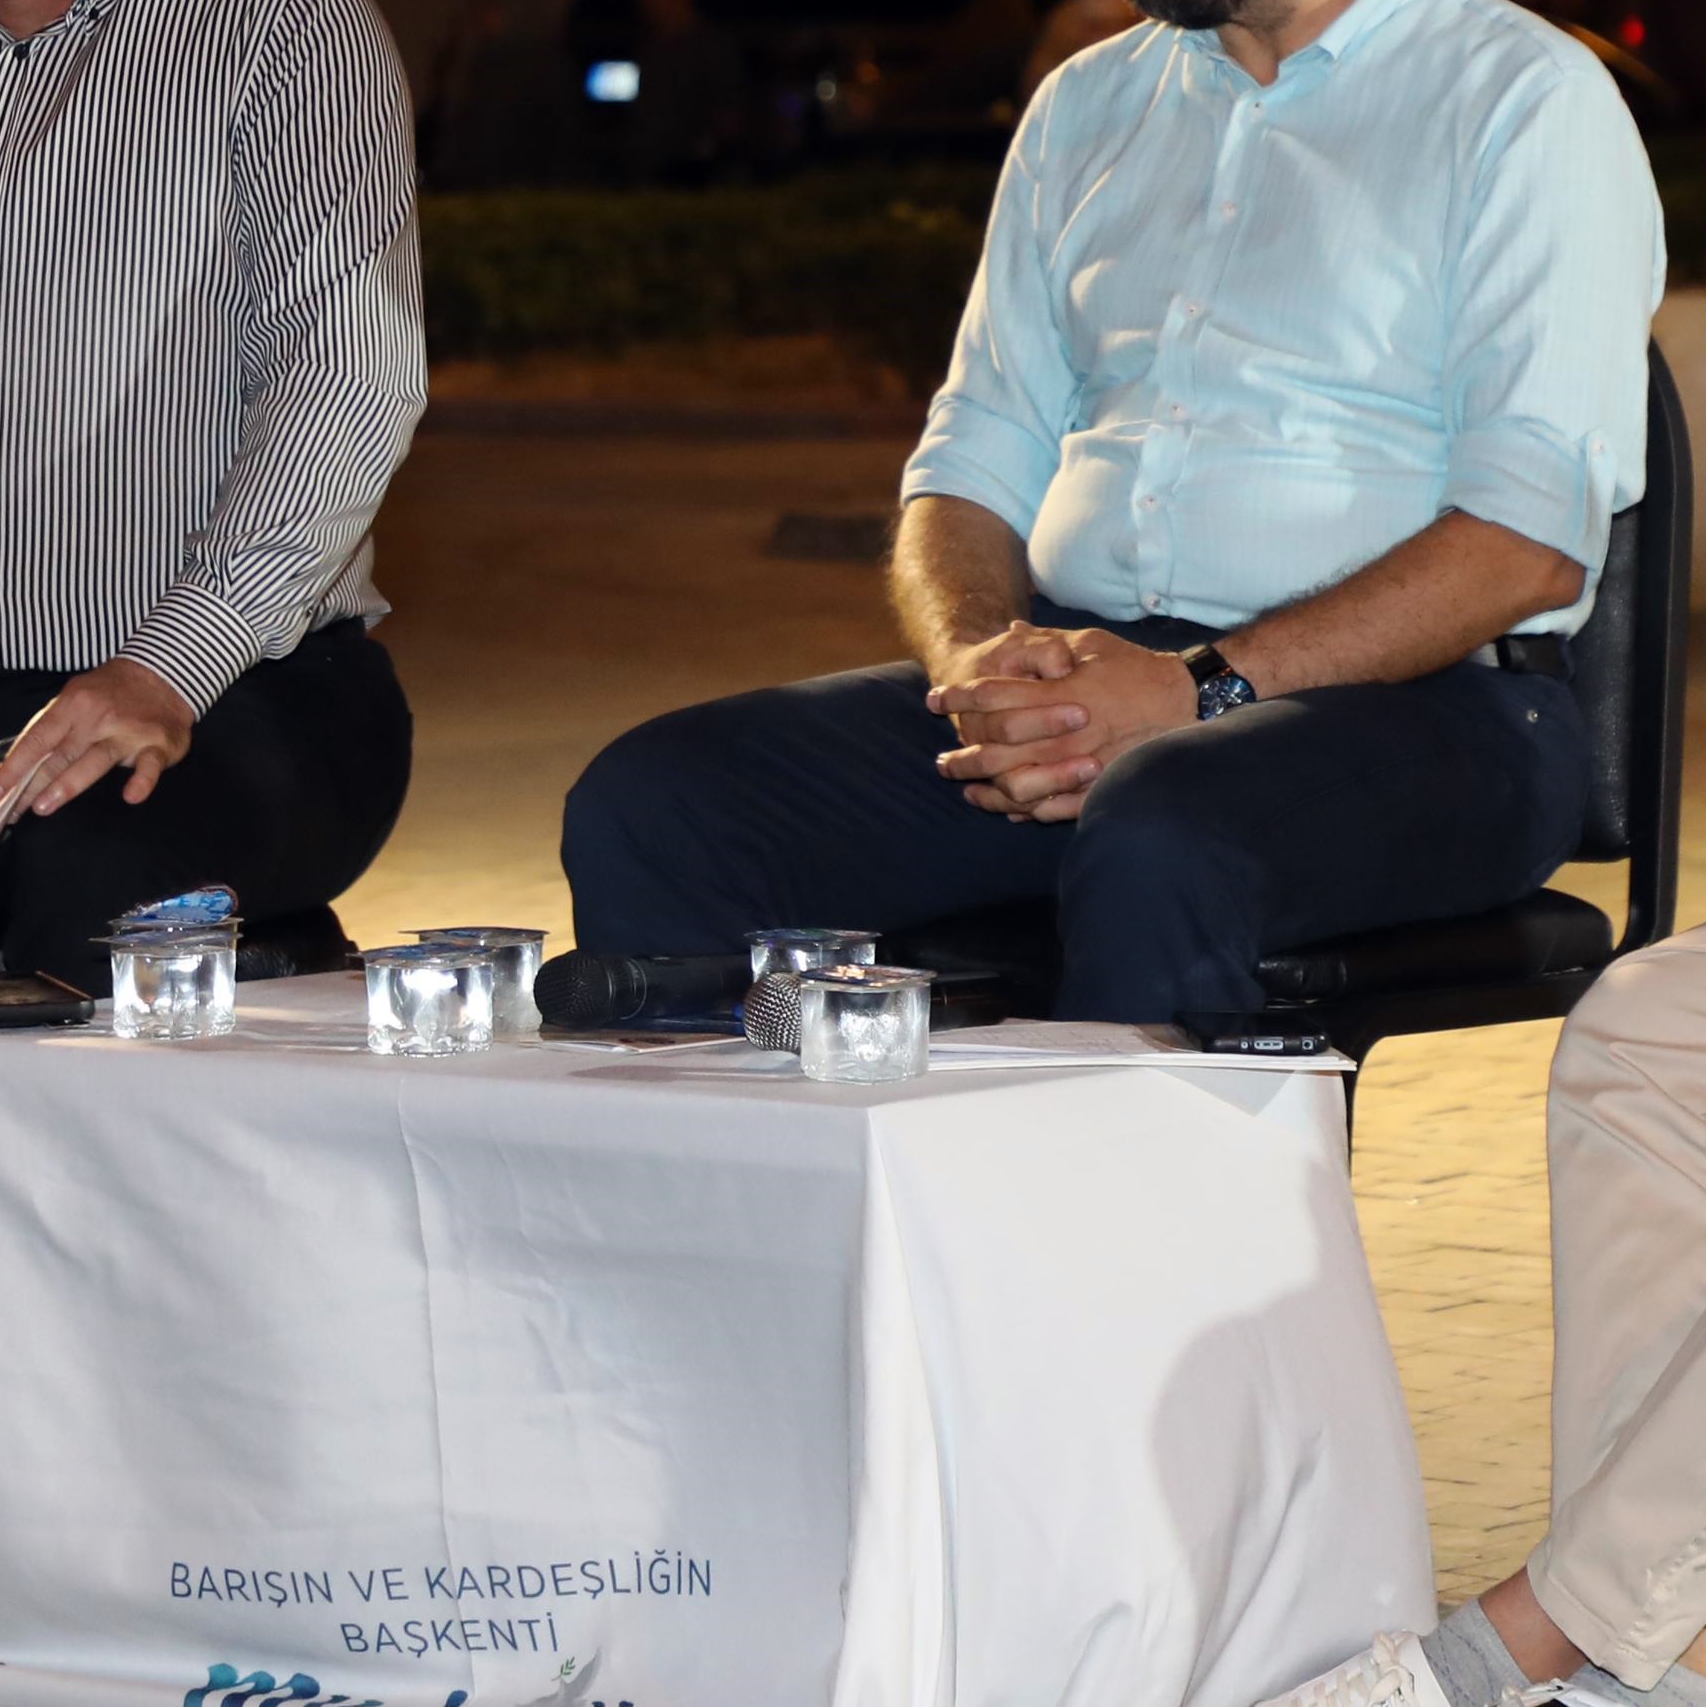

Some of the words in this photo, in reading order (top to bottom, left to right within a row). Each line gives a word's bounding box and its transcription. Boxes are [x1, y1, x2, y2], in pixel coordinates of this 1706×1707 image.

[169, 1561, 334, 1609] BARIŞIN
[348, 1567, 410, 1603] VE
[424, 1549, 713, 1601] KARDEŞLİĞİN
[339, 1611, 559, 1659] BAŞKENTİ
